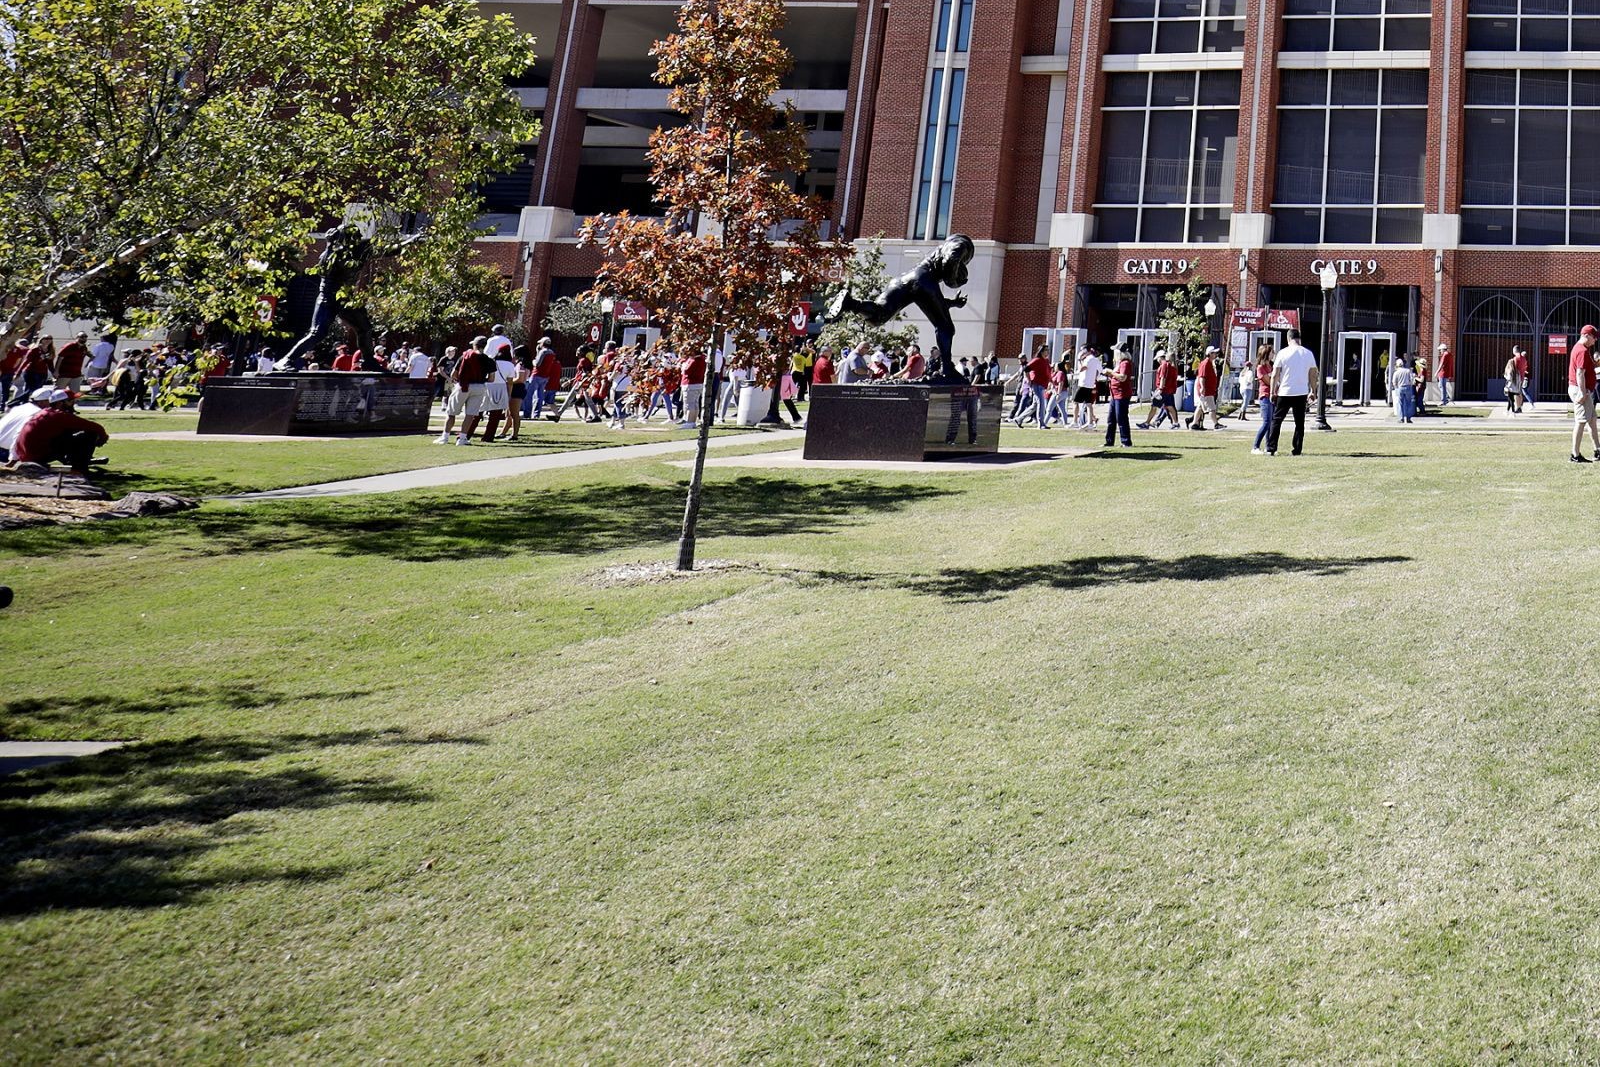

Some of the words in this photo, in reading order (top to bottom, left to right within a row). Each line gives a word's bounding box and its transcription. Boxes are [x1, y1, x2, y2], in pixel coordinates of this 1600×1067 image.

[1123, 259, 1173, 275] GATE
[1177, 259, 1188, 275] 9
[1367, 259, 1377, 275] 9
